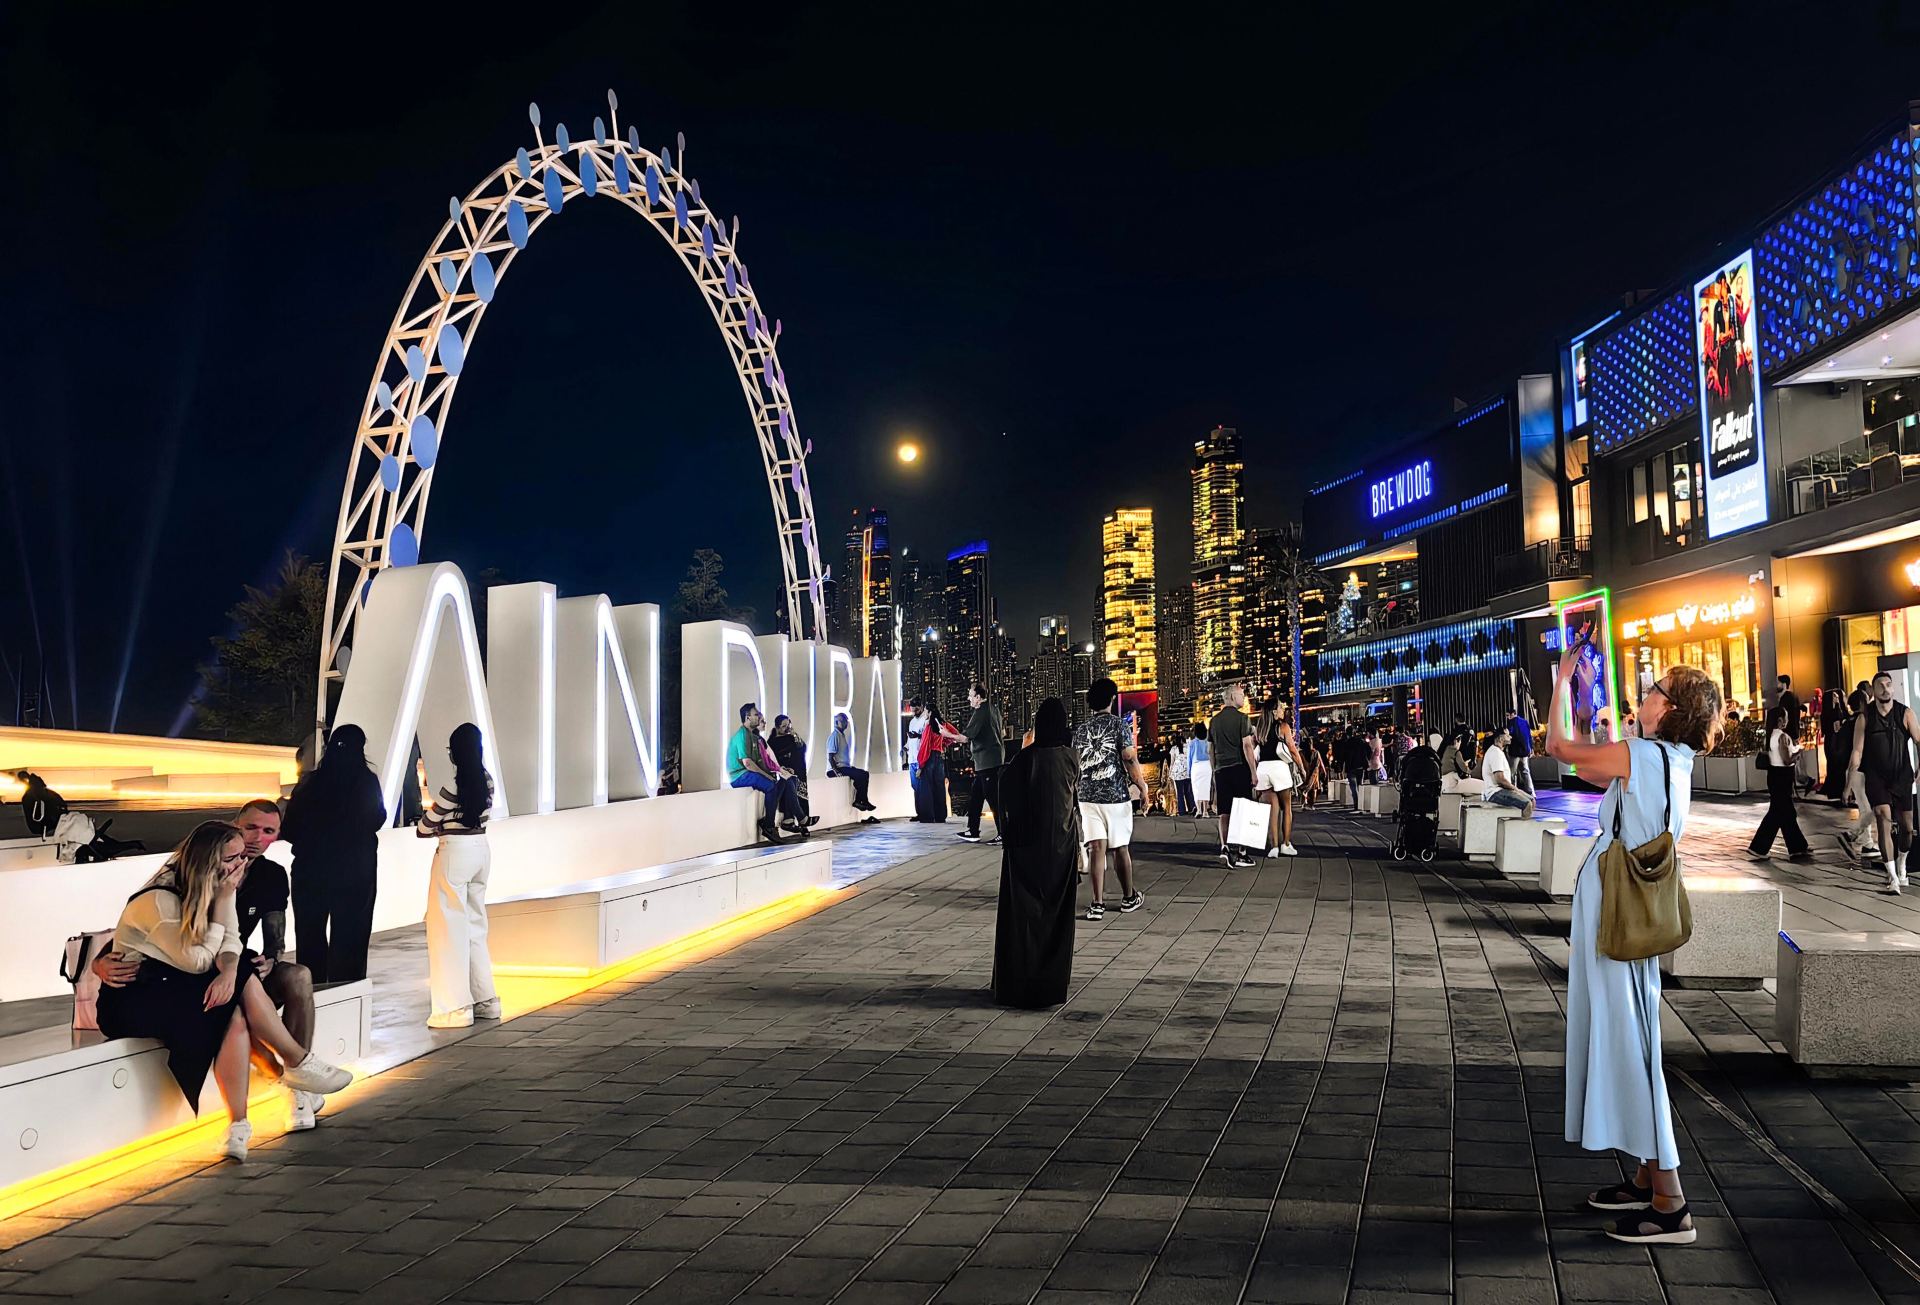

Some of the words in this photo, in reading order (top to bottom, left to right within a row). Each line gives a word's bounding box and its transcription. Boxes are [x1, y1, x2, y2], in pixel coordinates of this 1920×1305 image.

[1371, 460, 1430, 518] BREWDOG
[330, 560, 660, 829] AIN
[681, 619, 903, 790] DUBAI
